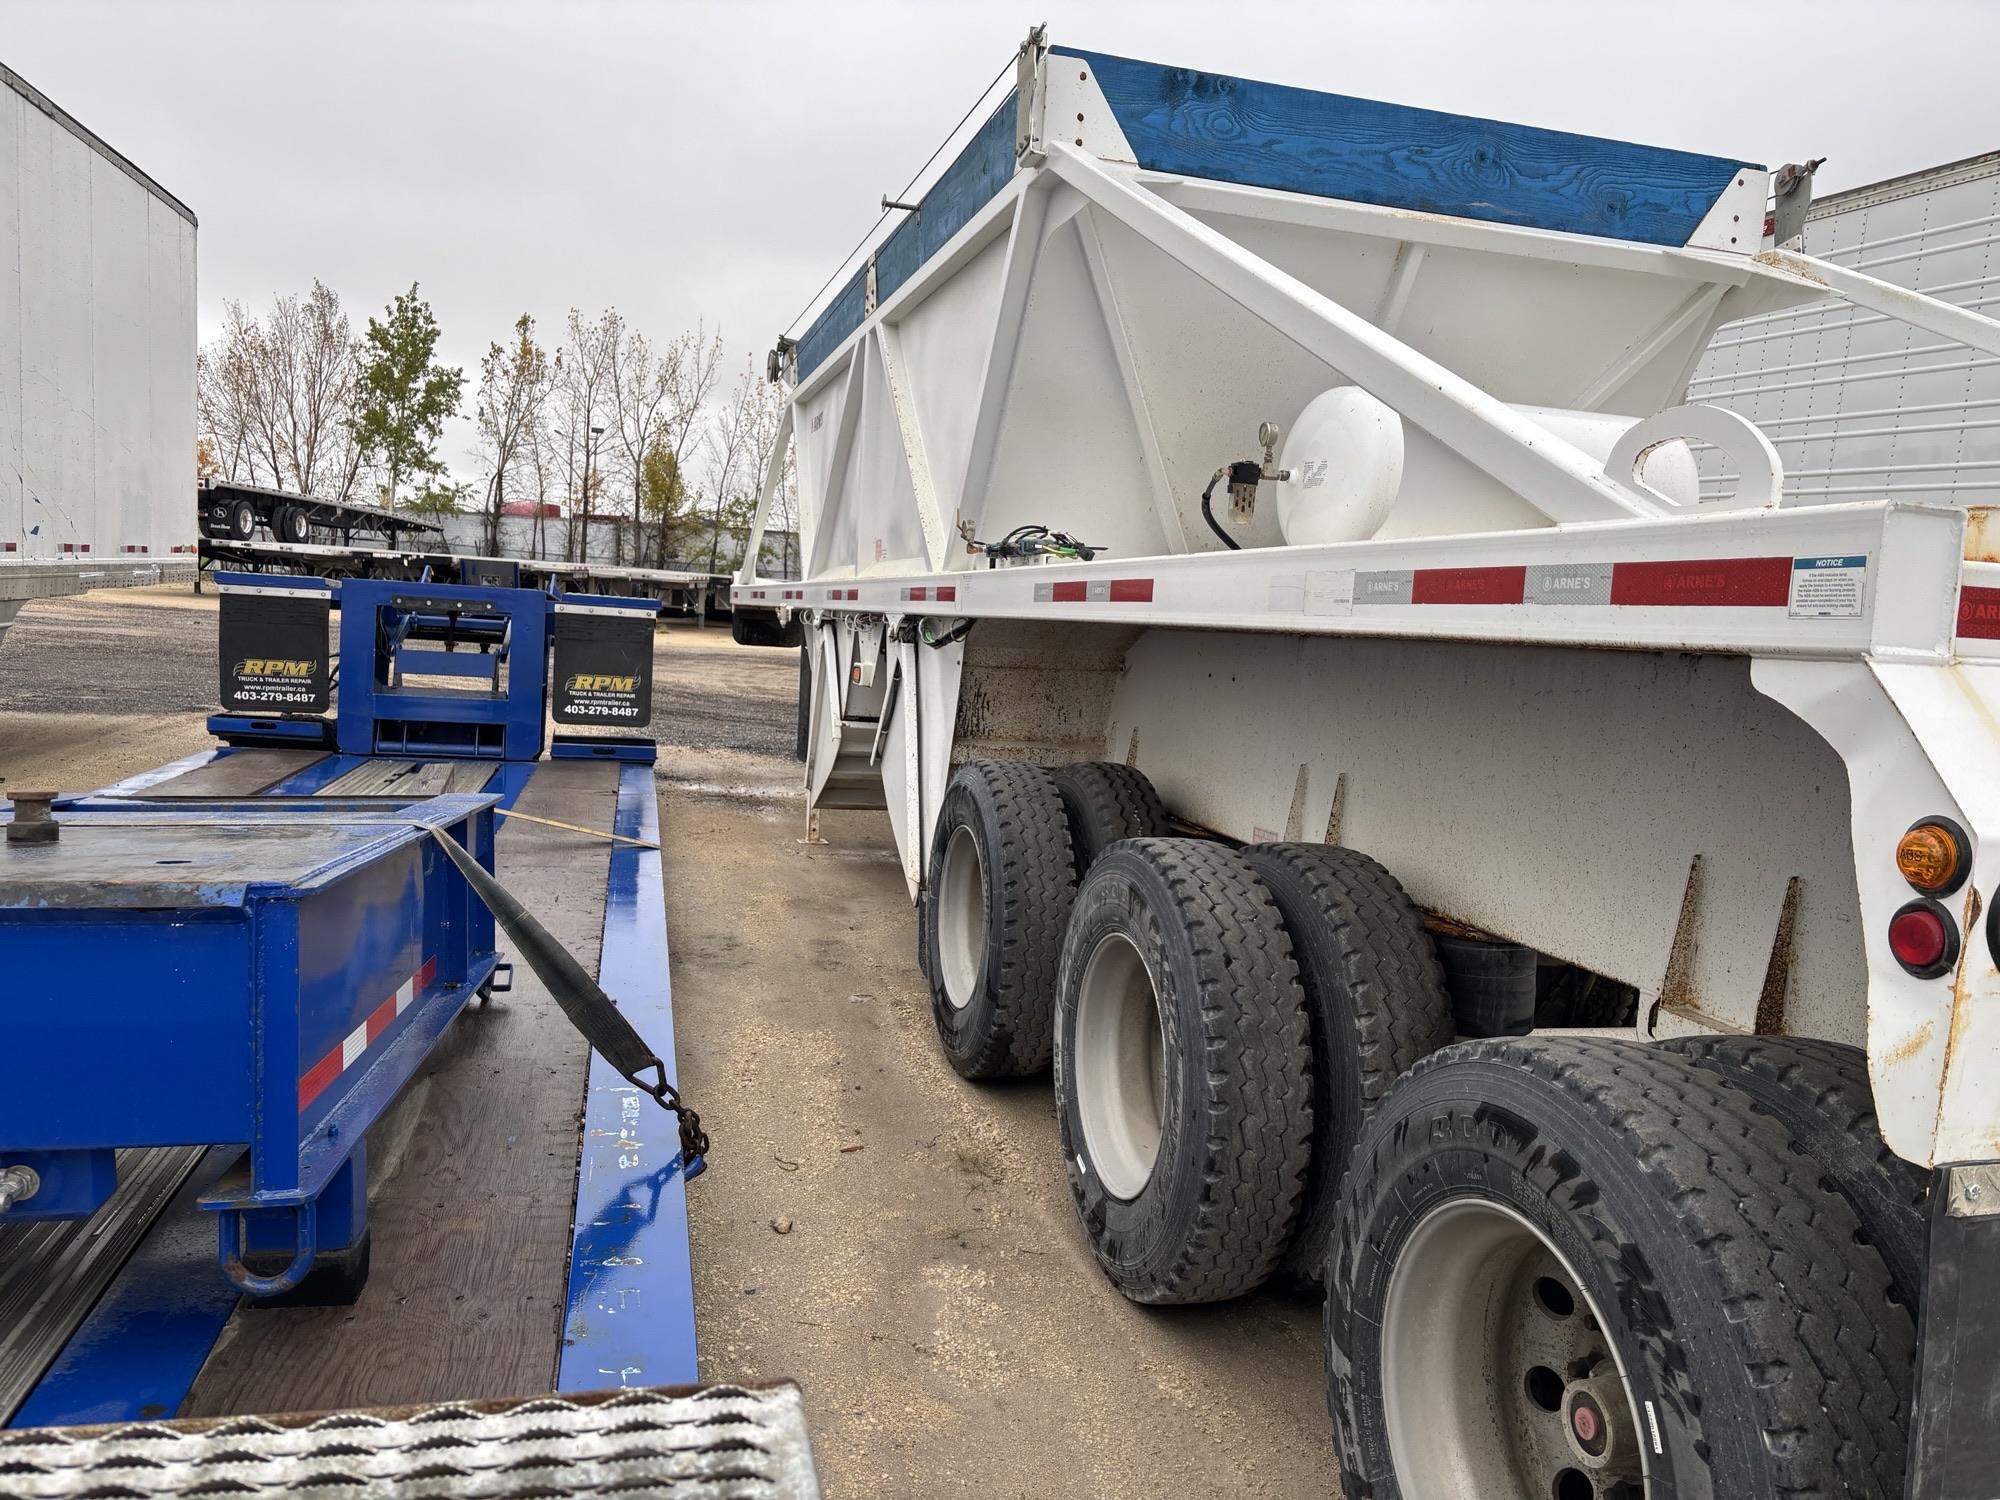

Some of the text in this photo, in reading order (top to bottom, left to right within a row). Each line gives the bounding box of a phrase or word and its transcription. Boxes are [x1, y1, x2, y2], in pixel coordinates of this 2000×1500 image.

[1815, 558, 1844, 567] NOTICE
[1374, 581, 1399, 593] ARNE'S
[1552, 576, 1591, 590] ARNE'S
[1676, 574, 1725, 589] ARNE'S
[240, 658, 312, 677] RPM
[244, 684, 306, 692] www.rpmtrailer.ca
[571, 674, 635, 692] RPM
[233, 691, 316, 702] 403-279-8487
[564, 705, 639, 717] 403-279-8487
